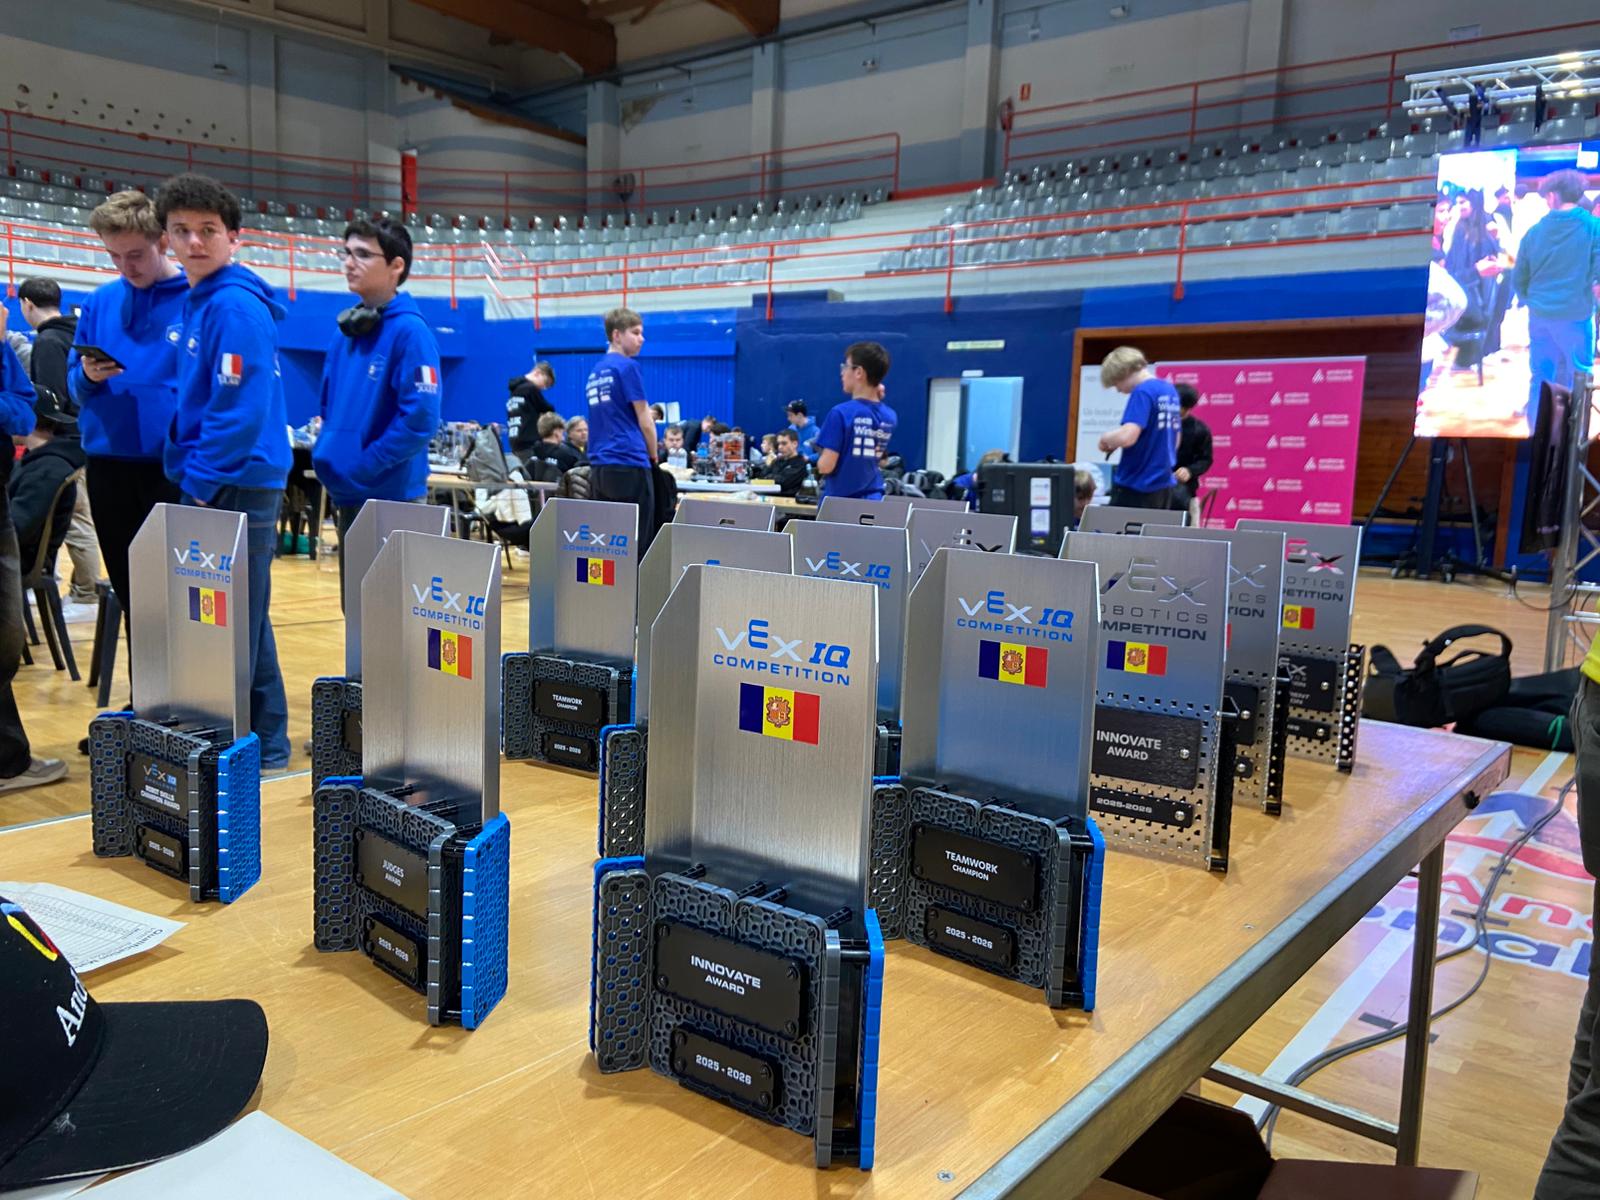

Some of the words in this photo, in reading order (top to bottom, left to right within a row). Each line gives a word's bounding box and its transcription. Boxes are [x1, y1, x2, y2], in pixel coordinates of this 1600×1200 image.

[563, 524, 606, 546] VEX
[609, 535, 628, 547] IQ
[174, 540, 216, 570] VEX
[805, 552, 862, 577] VEX
[865, 563, 891, 579] IQ
[175, 566, 231, 584] COMPETITIO
[1286, 575, 1345, 589] OTICS
[412, 576, 462, 612] VEX
[1283, 588, 1343, 602] ETITION
[412, 606, 484, 631] COMPETITIO
[958, 590, 1033, 625] VEX
[1038, 608, 1074, 629] IQ
[957, 618, 1073, 643] COMPETITION
[1102, 620, 1206, 641] MPETITION
[715, 619, 803, 663] VEX
[809, 641, 850, 669] IQ
[713, 654, 850, 687] COMPETITION
[552, 693, 583, 706] TEAMWORK
[1096, 730, 1162, 750] INNOVATE
[1106, 746, 1149, 761] AWARD
[382, 859, 405, 878] JUDGES
[945, 850, 998, 875] TEAMWORK
[952, 864, 989, 881] CHAMPION
[945, 926, 966, 940] 2025
[971, 935, 993, 950] 2026
[690, 954, 761, 989] INNOVATE
[705, 974, 745, 996] AWARD
[696, 1054, 720, 1073] 2025
[727, 1067, 752, 1086] 2026
